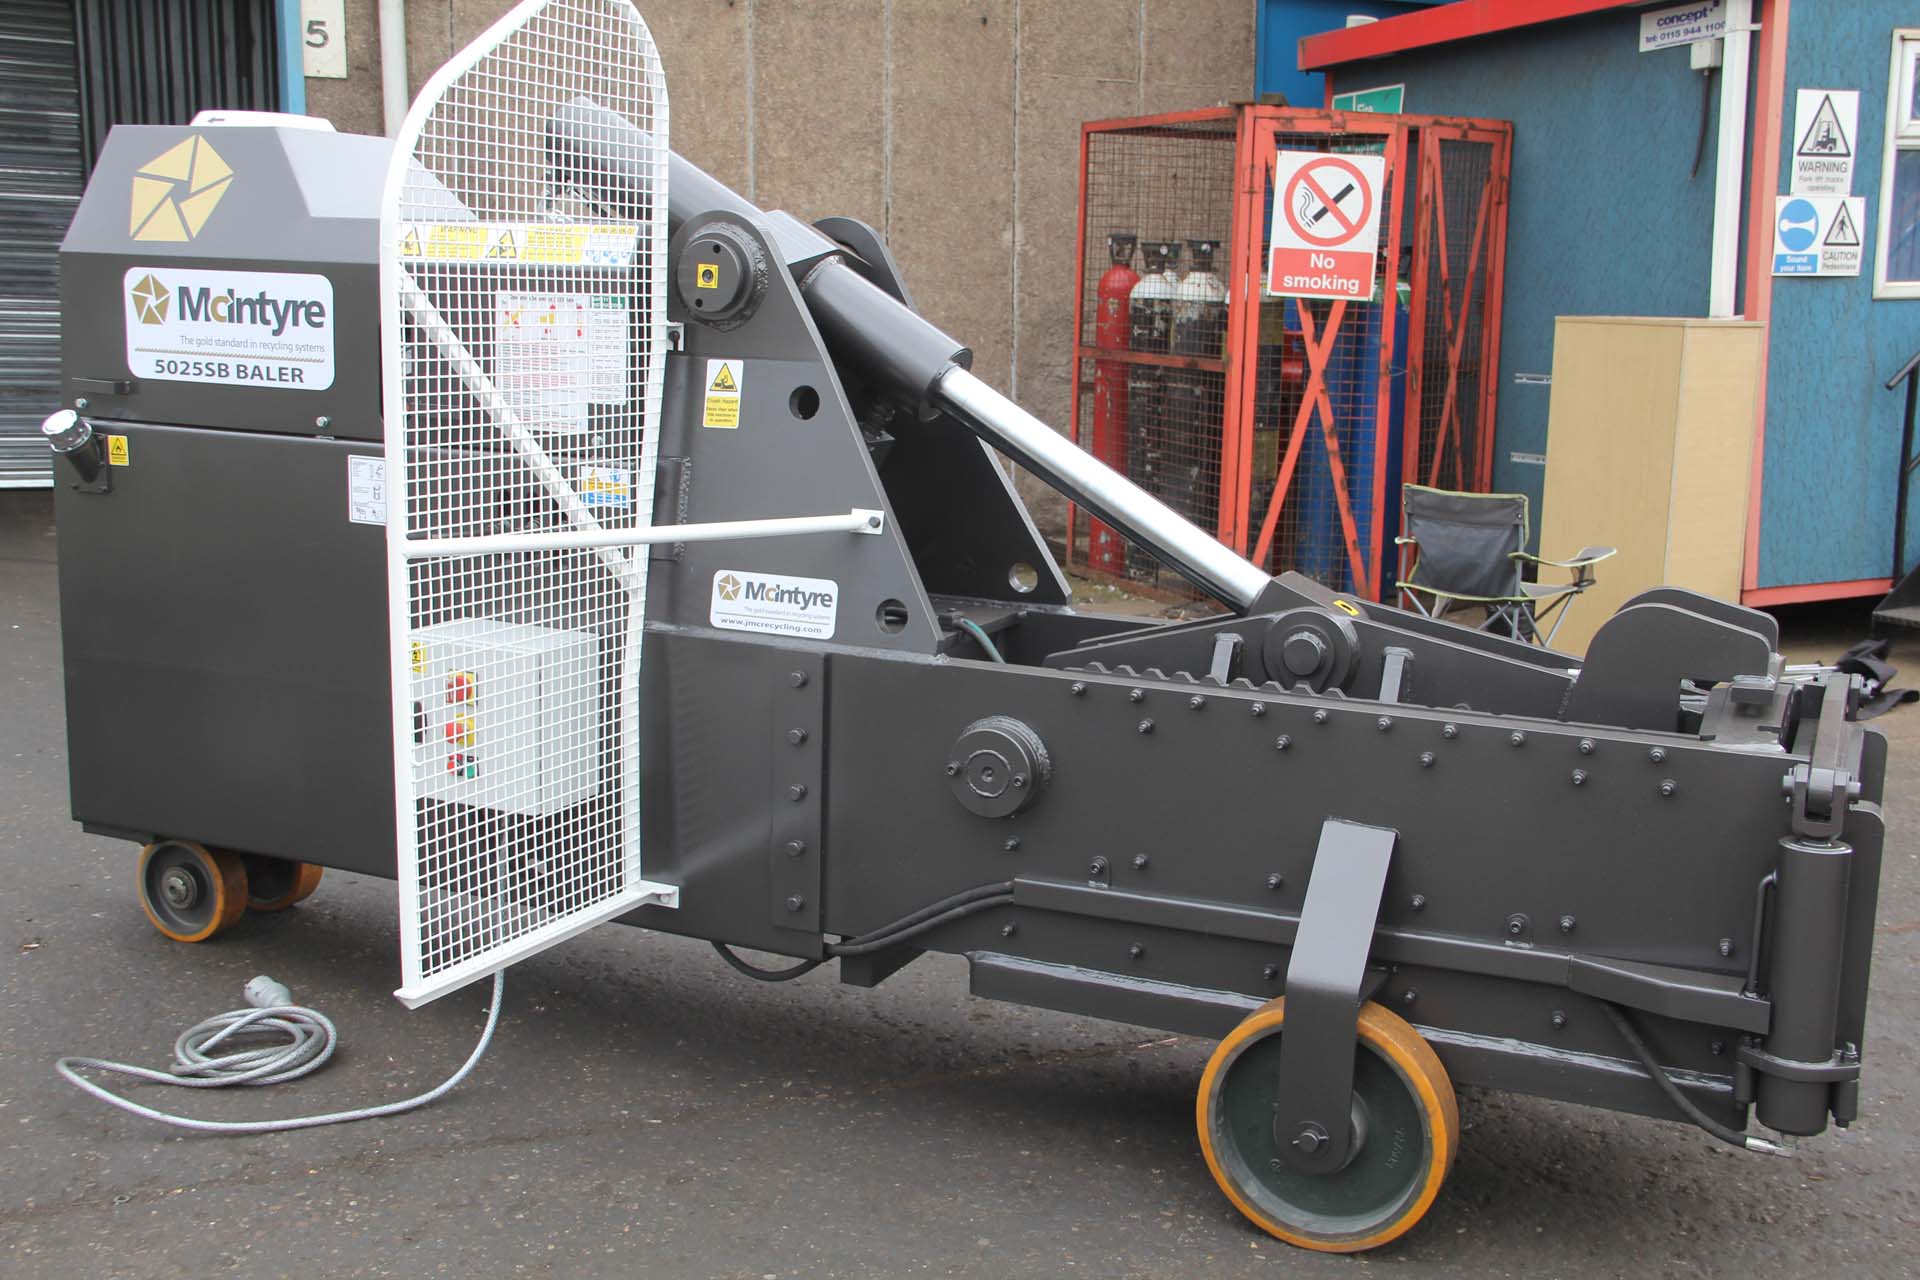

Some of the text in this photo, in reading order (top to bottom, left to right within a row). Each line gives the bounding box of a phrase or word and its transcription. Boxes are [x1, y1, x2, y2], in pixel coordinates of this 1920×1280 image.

[1656, 6, 1708, 27] concept
[305, 20, 329, 49] 5
[1660, 29, 1681, 40] 0115
[1682, 26, 1702, 36] 944
[1798, 161, 1848, 173] WARNING
[1309, 253, 1336, 270] No
[1823, 251, 1858, 261] CAUTION
[1283, 274, 1360, 293] smoking
[181, 335, 325, 353] The gold standard in recycling systems
[154, 359, 305, 384] 5025SB BALER
[720, 617, 822, 634] www.jmcrecycling.com
